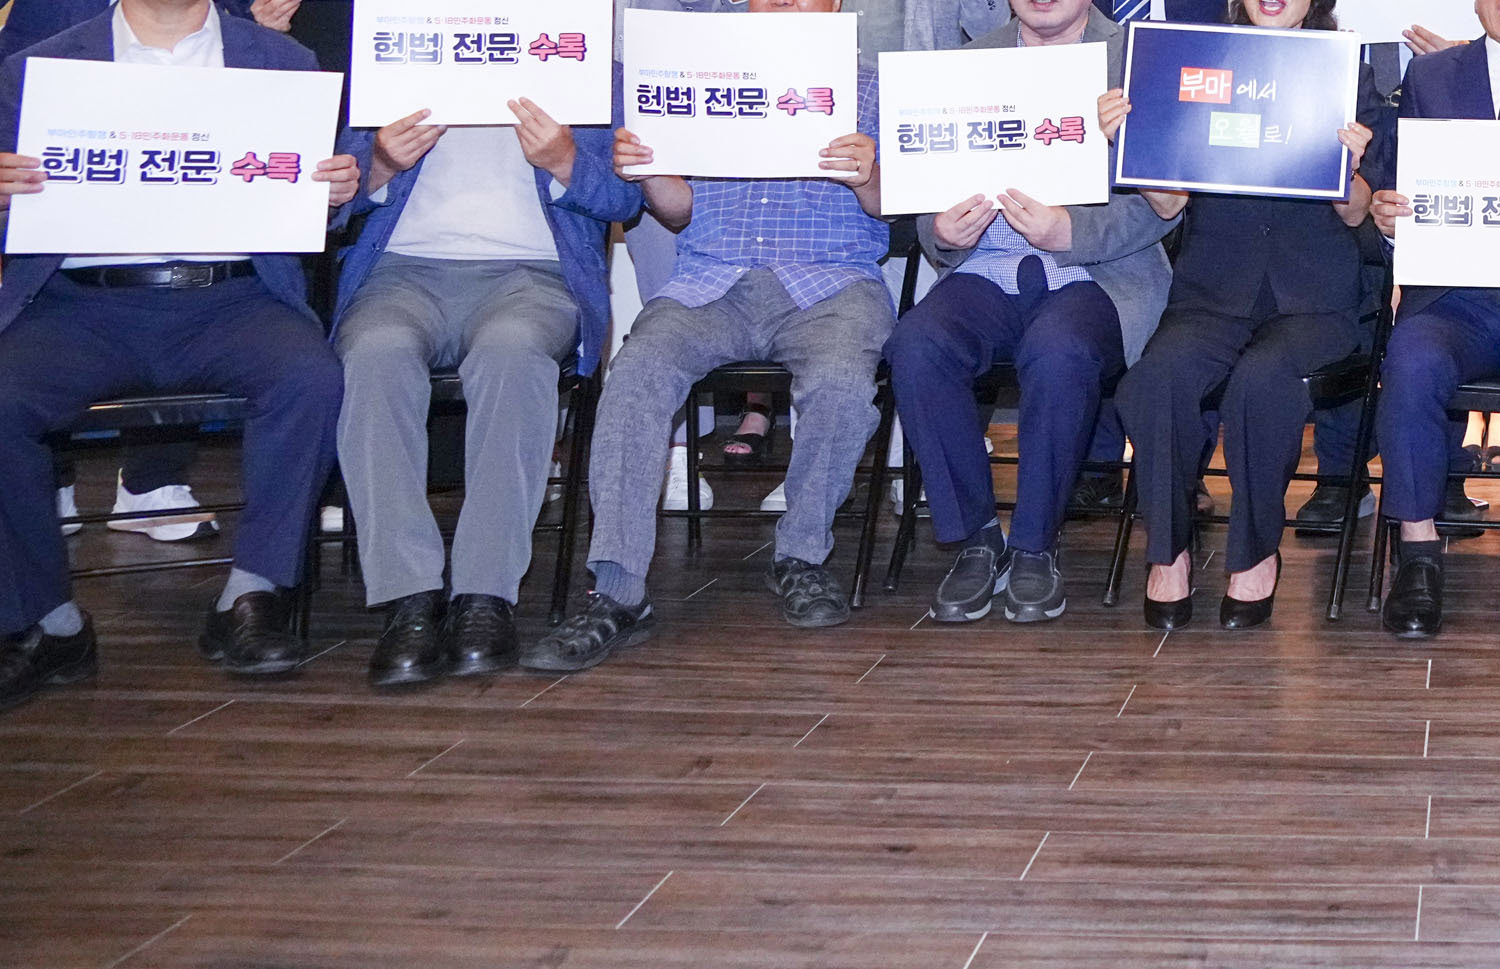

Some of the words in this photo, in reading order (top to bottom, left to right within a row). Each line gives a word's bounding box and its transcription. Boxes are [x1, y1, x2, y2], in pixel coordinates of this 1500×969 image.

[373, 31, 443, 64] 헌법
[452, 32, 521, 64] 전문
[528, 32, 587, 62] 수록
[636, 84, 696, 118] 헌법
[704, 87, 769, 119] 전문
[776, 87, 835, 116] 수록
[897, 120, 958, 154] 헌법
[966, 118, 1028, 151] 전문
[1034, 115, 1086, 145] 수록
[42, 146, 128, 184] 헌법
[139, 149, 221, 185] 전문
[230, 151, 301, 183] 수록
[1413, 194, 1473, 226] 헌법
